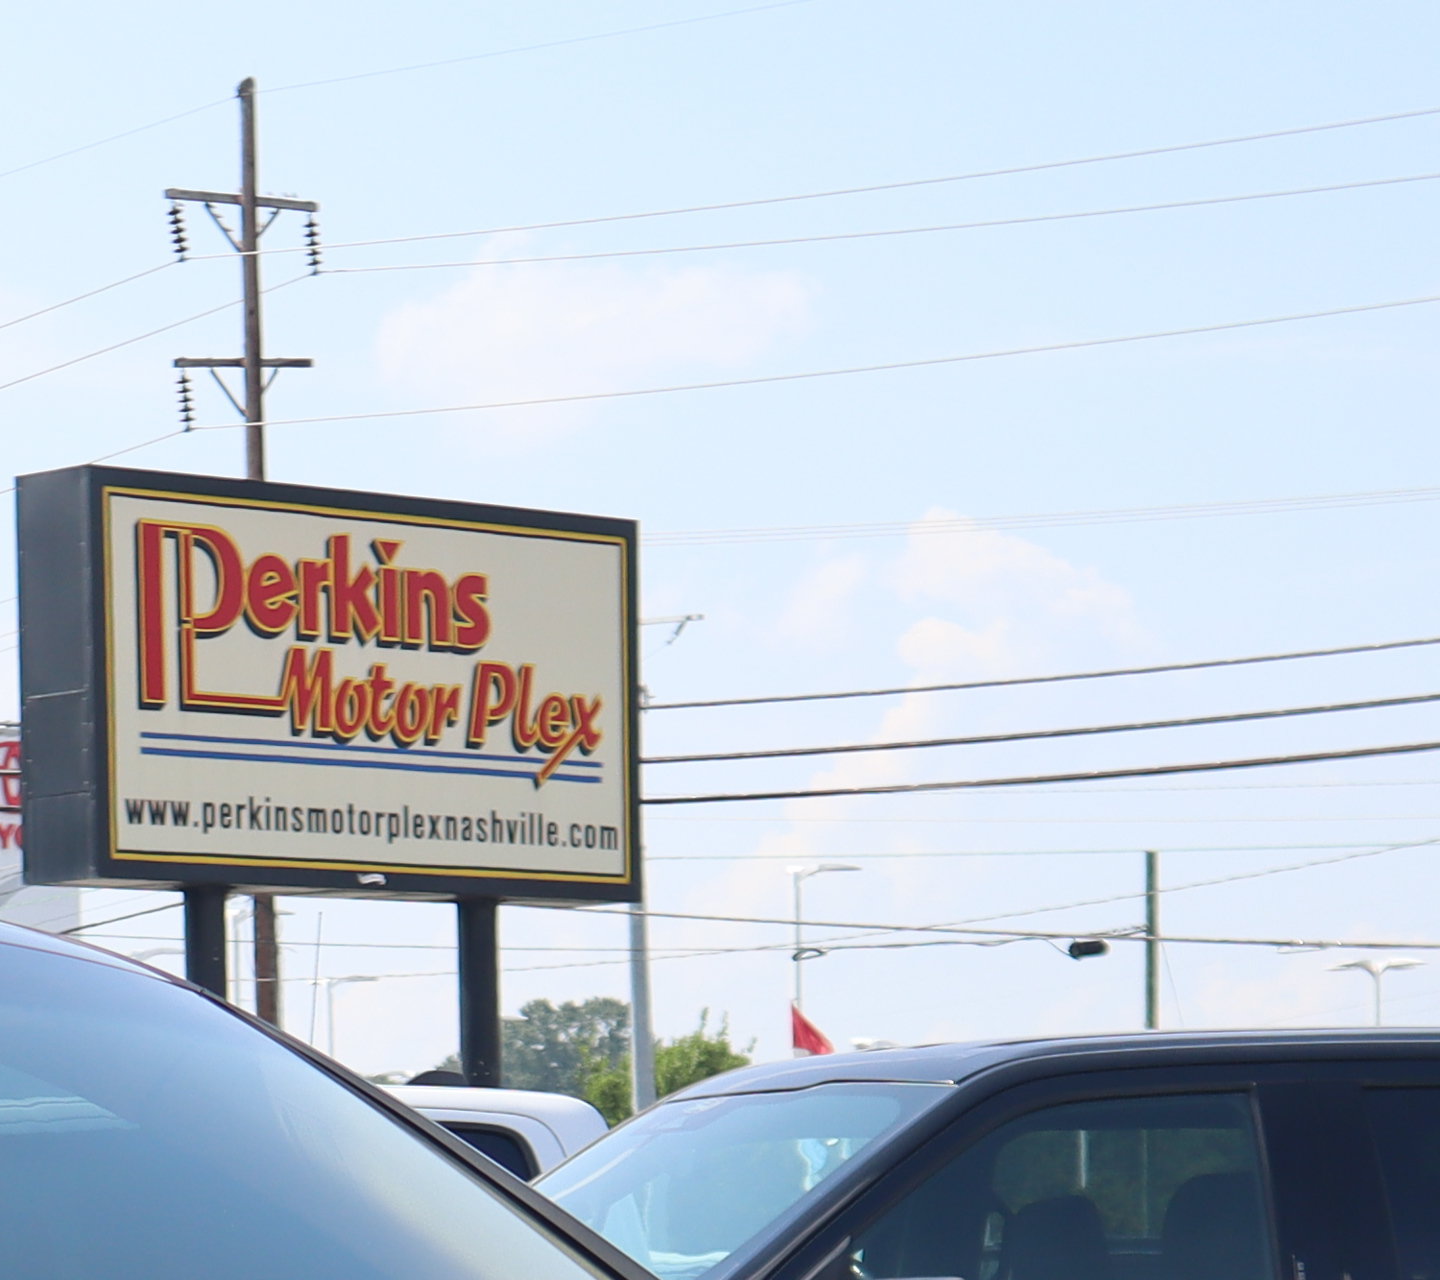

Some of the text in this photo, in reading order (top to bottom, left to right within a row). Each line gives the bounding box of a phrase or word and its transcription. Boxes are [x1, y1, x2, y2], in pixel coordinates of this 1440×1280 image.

[138, 518, 492, 706] Perkins
[282, 645, 605, 789] Motor Plex
[124, 796, 619, 850] www.perkinsmotorplexnashville.com
